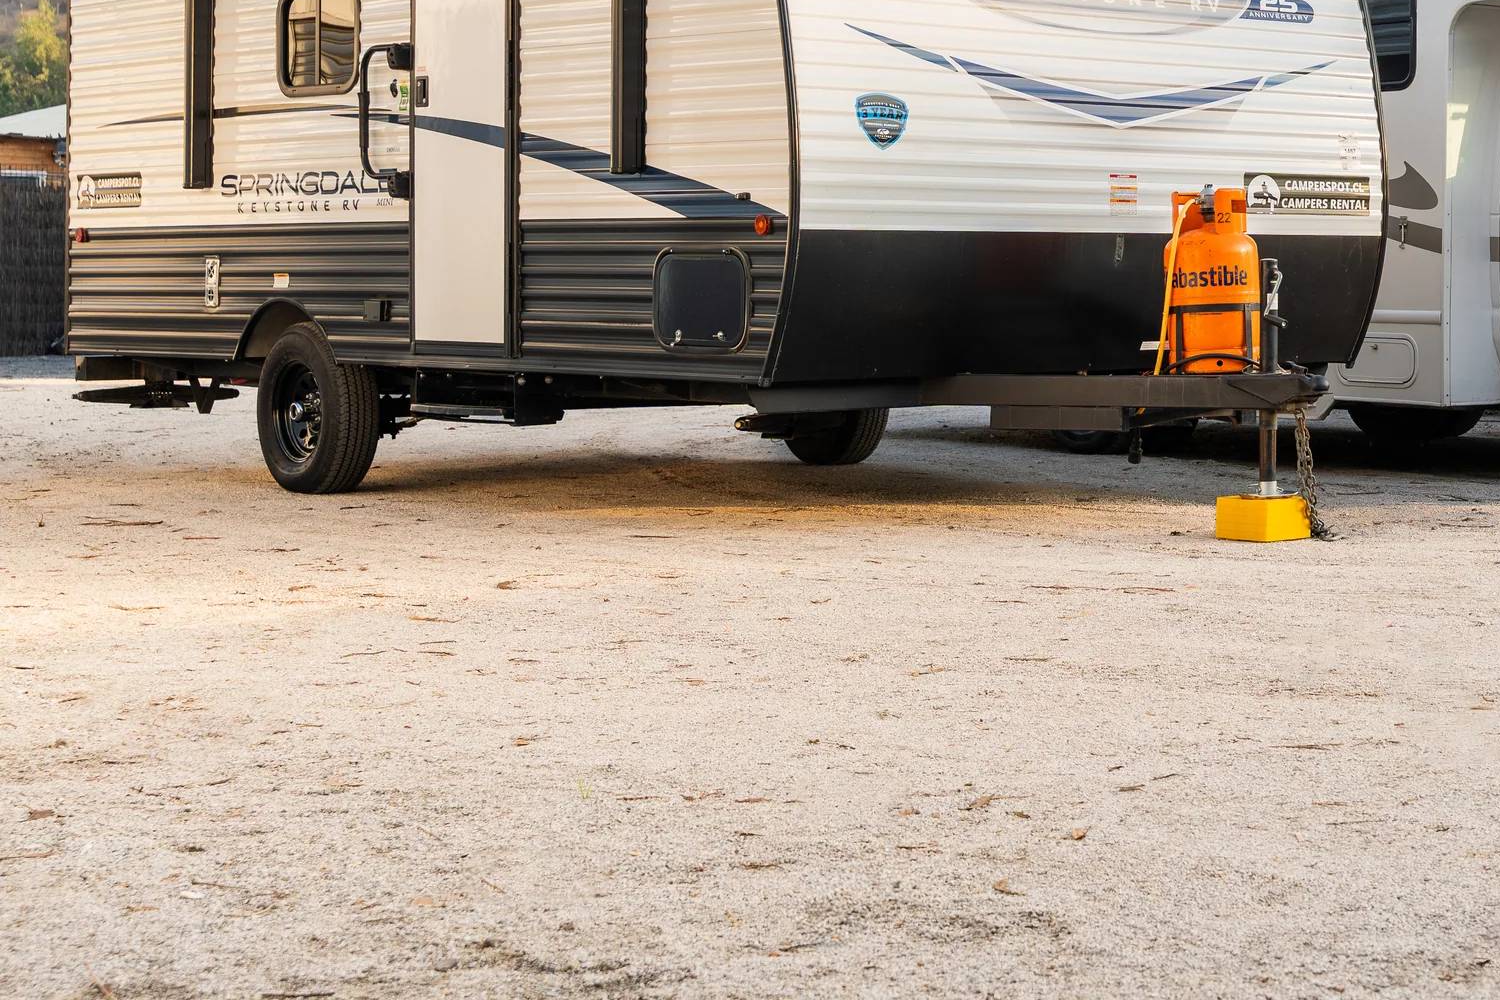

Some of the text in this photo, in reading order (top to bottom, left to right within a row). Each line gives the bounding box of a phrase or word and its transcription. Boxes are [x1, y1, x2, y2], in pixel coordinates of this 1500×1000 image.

[1249, 12, 1308, 21] ANNIVERSARY
[1284, 180, 1365, 193] CAMPERSPOT.CL
[237, 199, 360, 214] KEYSTONE RV
[1281, 197, 1368, 210] CAMPERS RENTAL
[1217, 212, 1231, 223] 22
[1172, 265, 1247, 288] abastible
